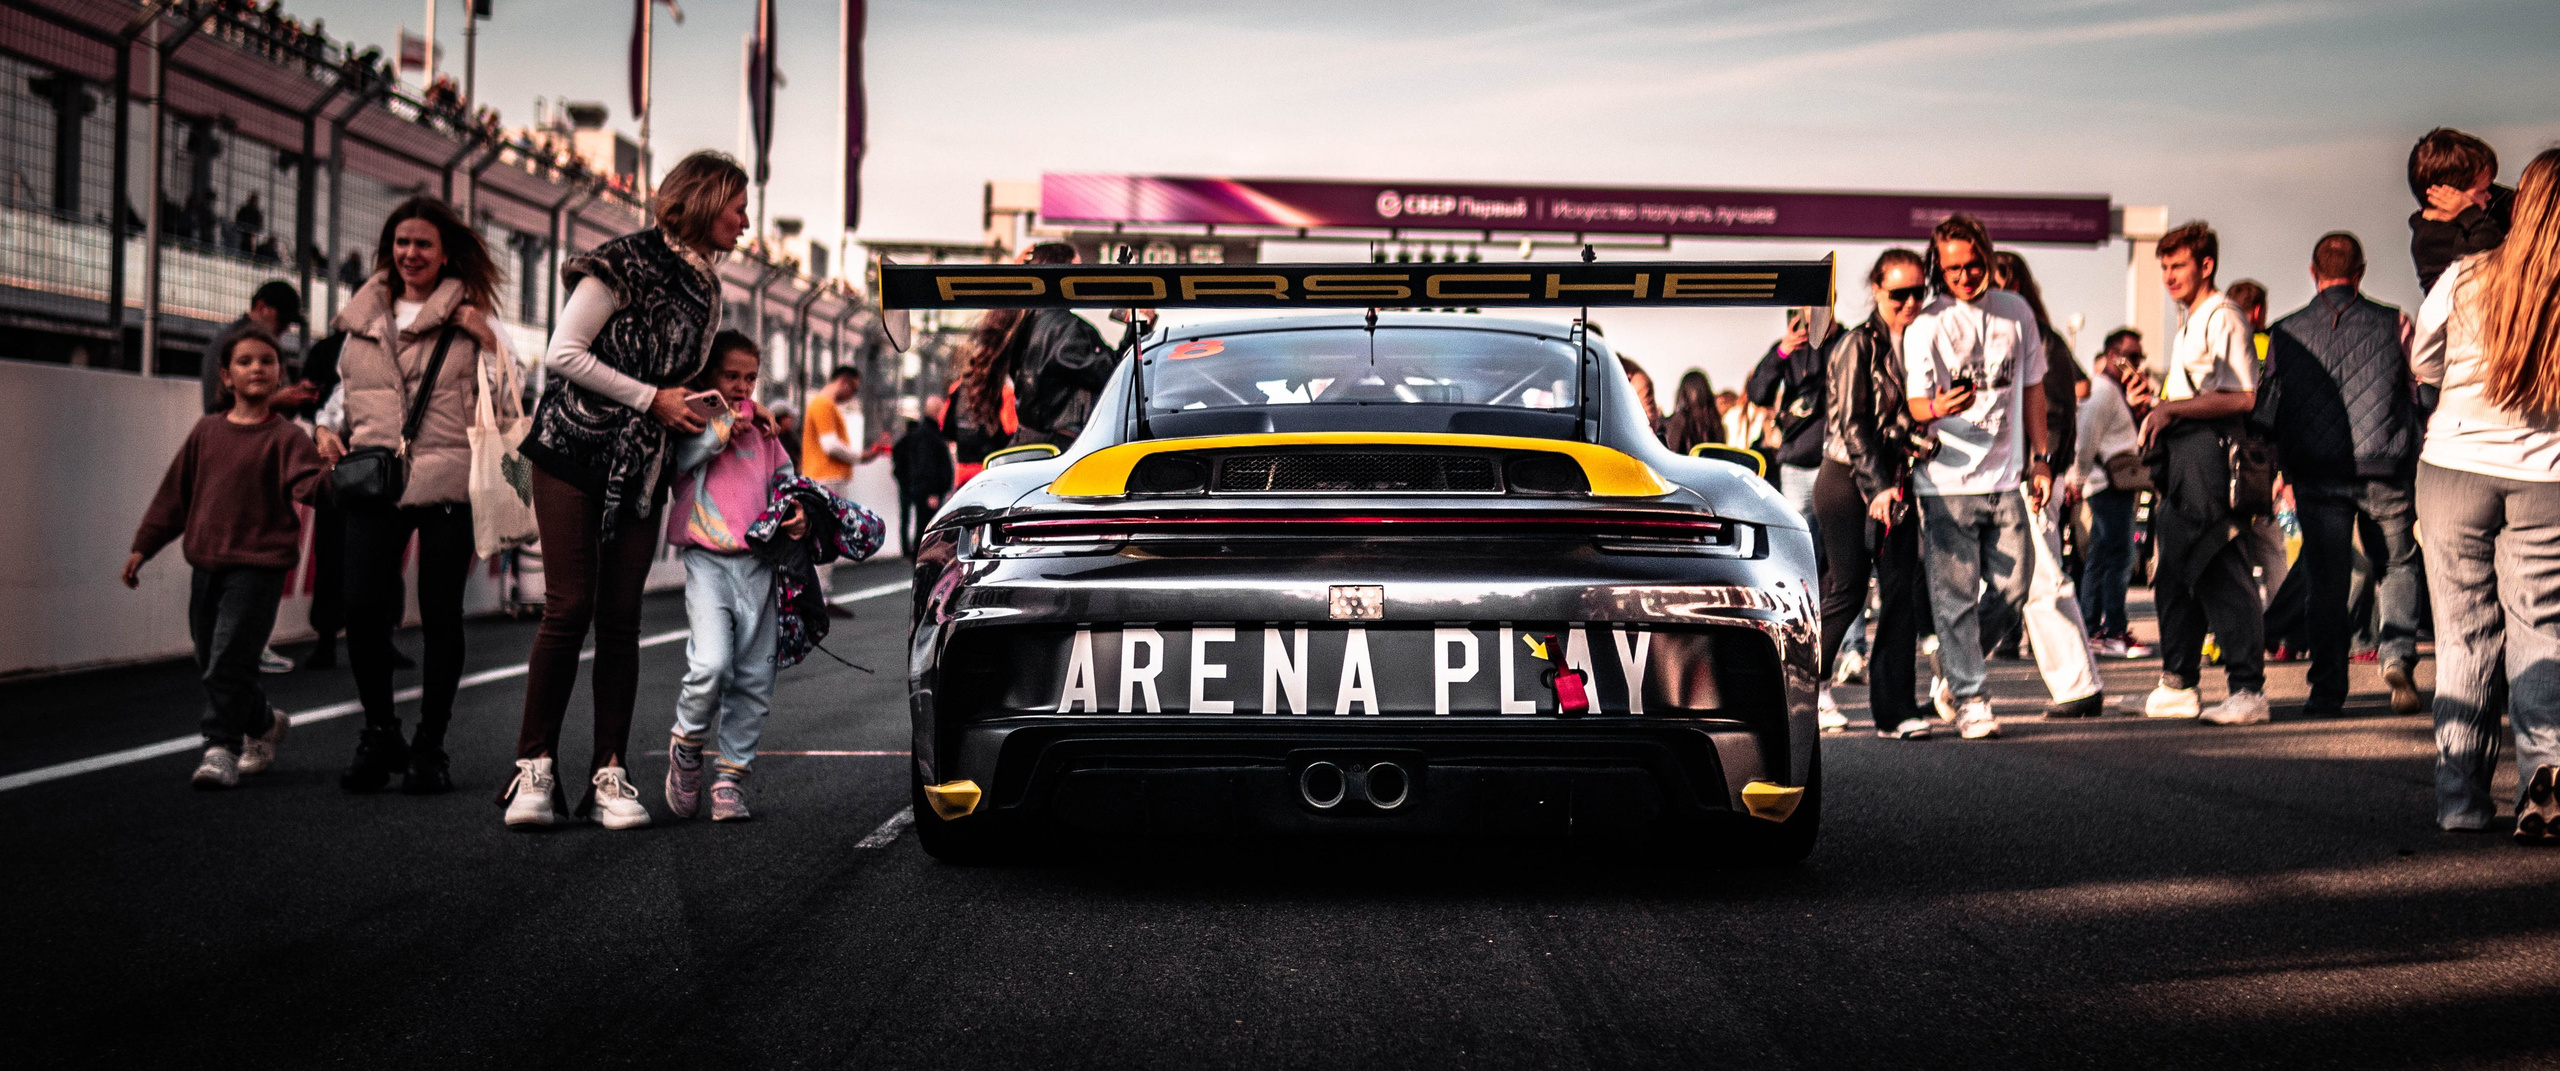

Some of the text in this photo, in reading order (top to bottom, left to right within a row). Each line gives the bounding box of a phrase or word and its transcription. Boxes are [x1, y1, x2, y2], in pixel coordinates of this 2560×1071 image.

[936, 273, 1779, 301] PORSCHE
[1057, 623, 1652, 715] ARENA PLAY
